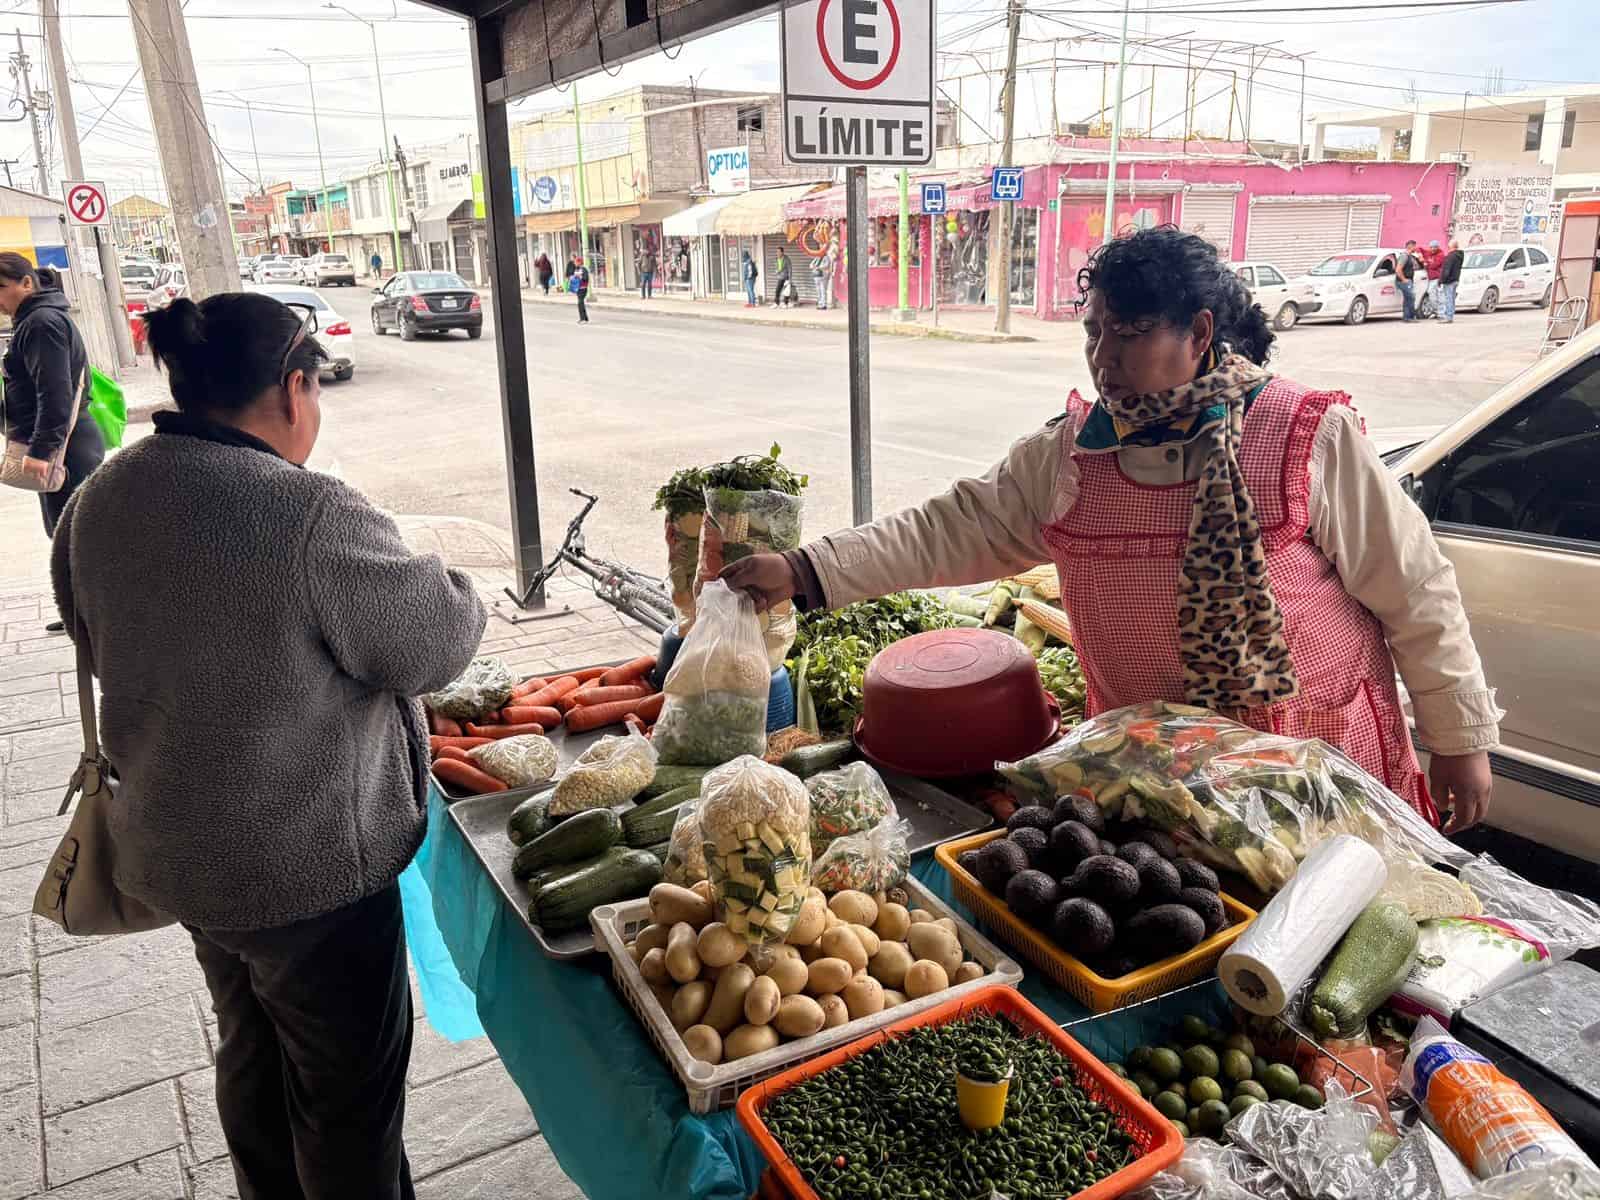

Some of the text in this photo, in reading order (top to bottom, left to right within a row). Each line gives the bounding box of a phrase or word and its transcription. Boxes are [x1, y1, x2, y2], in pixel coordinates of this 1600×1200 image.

[842, 0, 879, 64] E
[794, 106, 923, 156] LÍMITE
[708, 151, 748, 176] OPTICA
